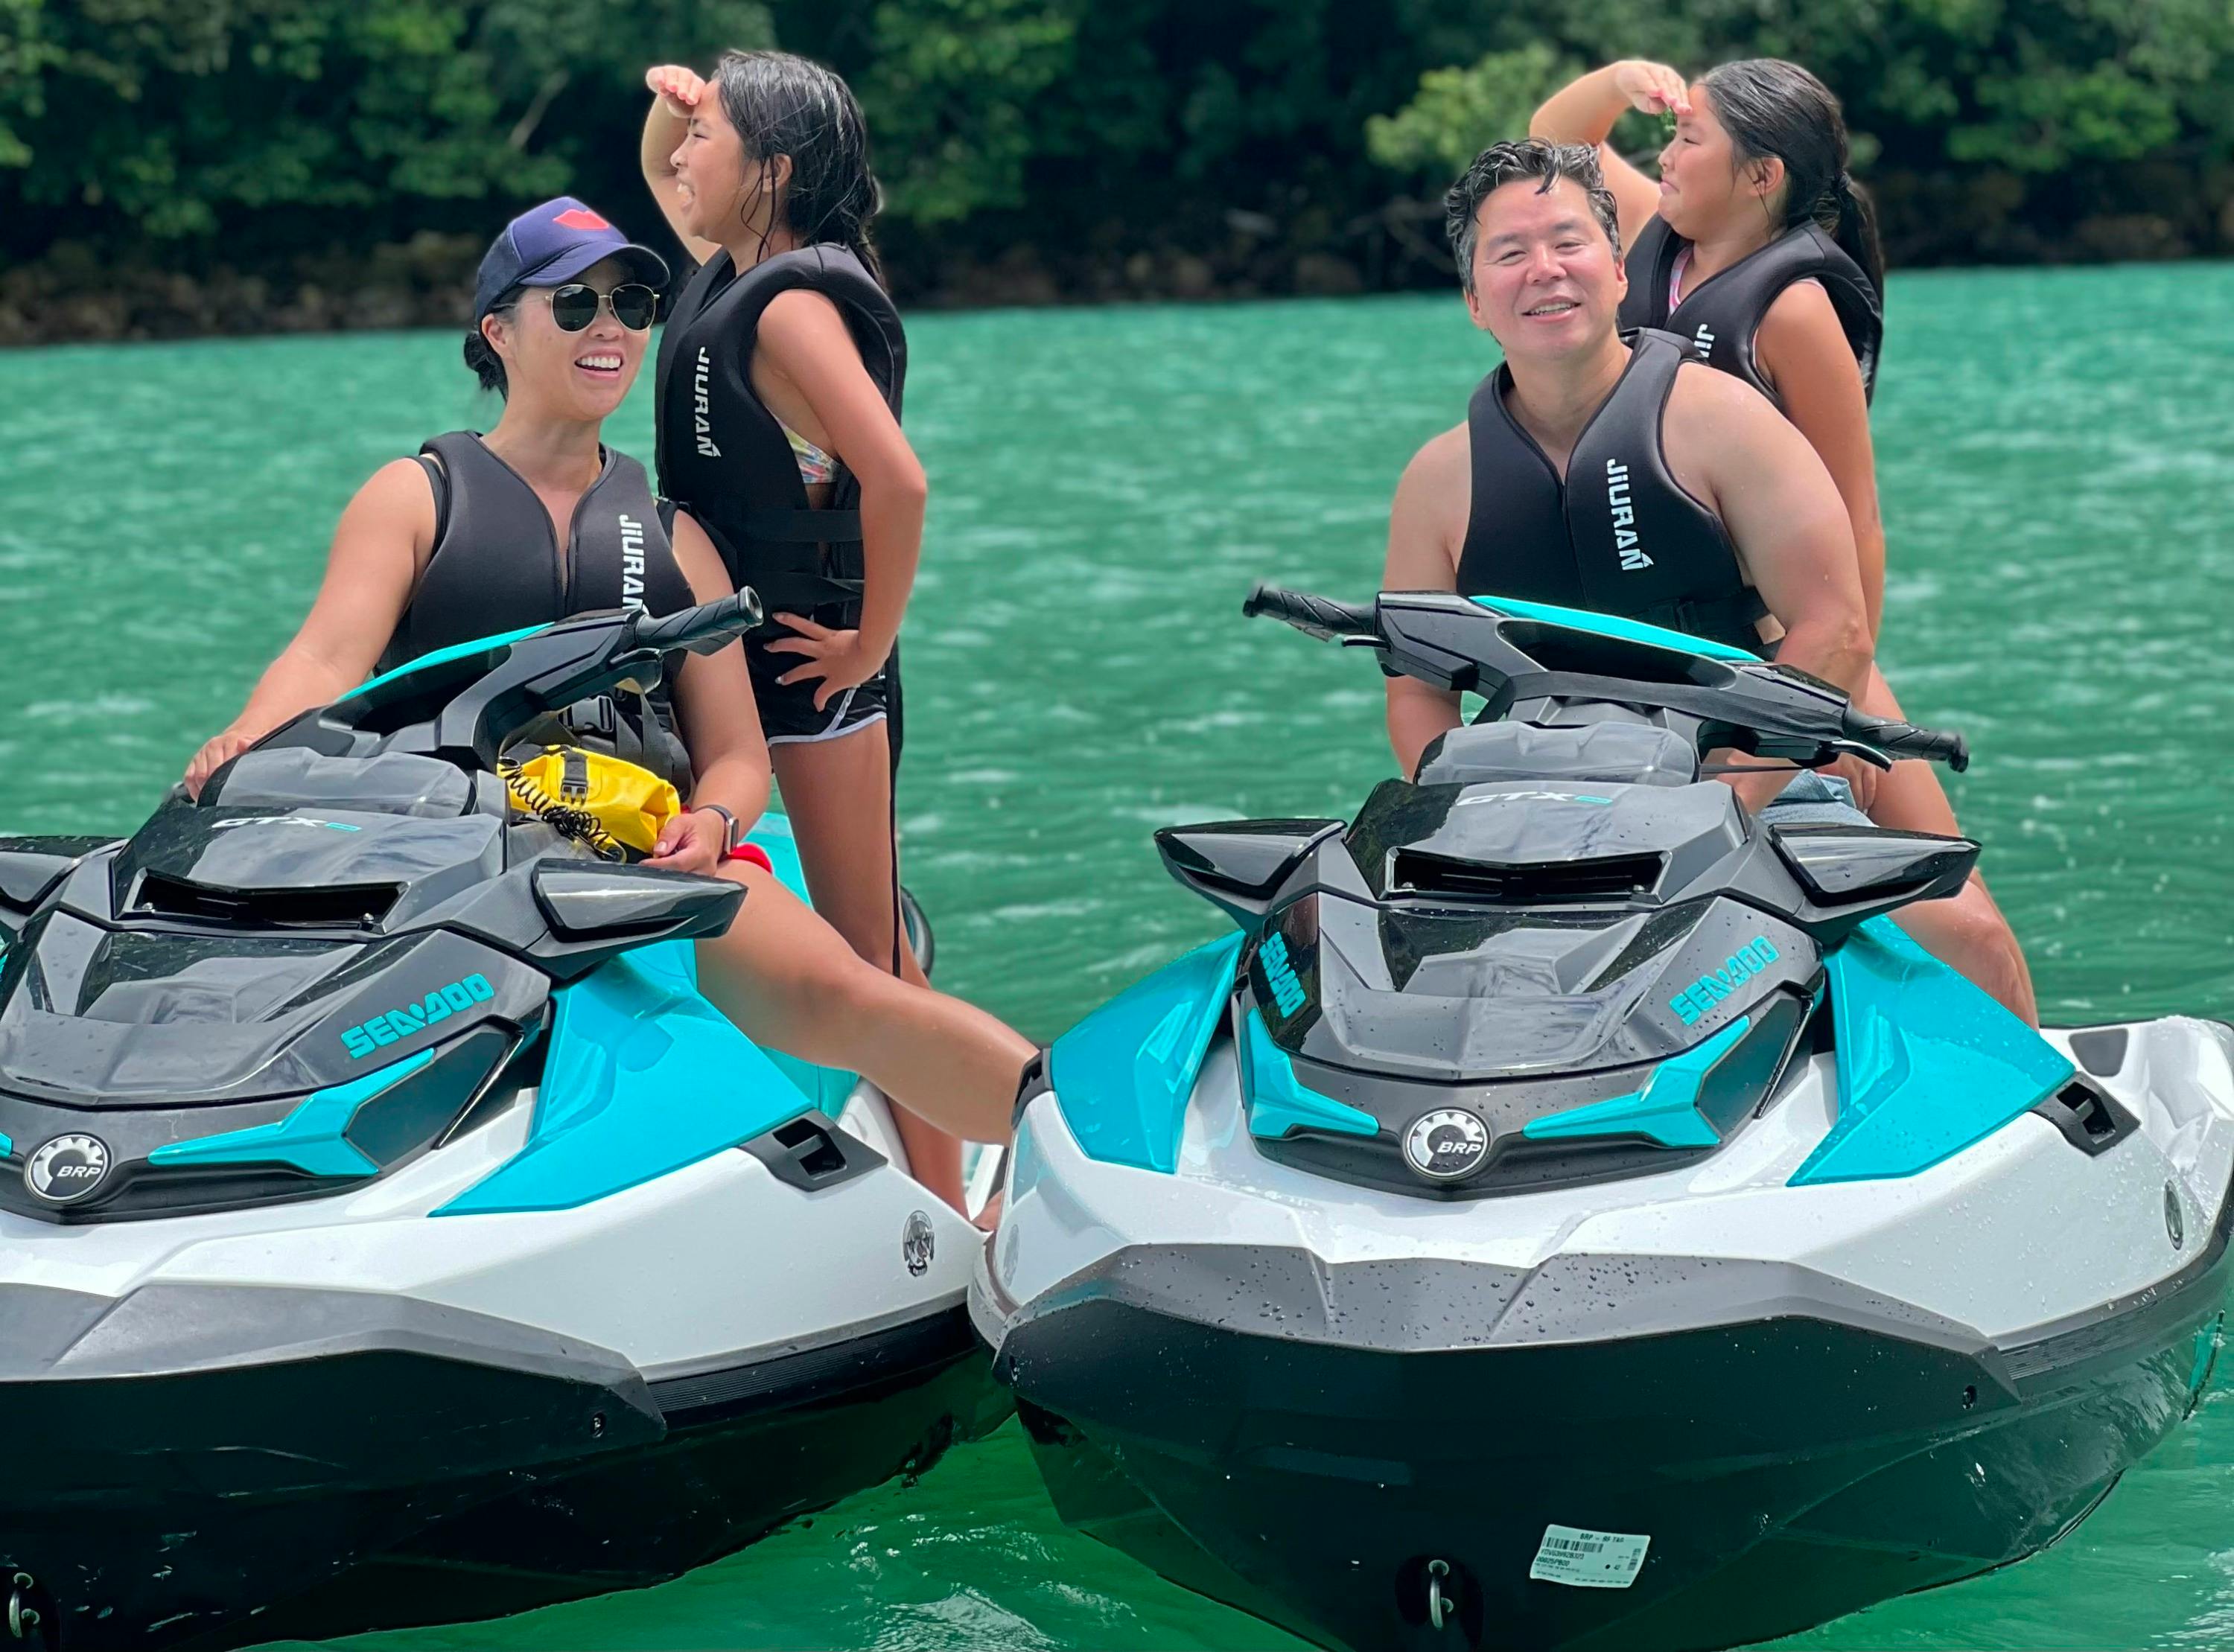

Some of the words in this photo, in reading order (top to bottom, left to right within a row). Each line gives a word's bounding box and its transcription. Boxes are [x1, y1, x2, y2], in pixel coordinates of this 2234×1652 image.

[1456, 791, 1576, 806] GTX
[211, 817, 328, 829] GTX
[1436, 1141, 1482, 1155] BRP
[57, 1165, 101, 1178] BRP
